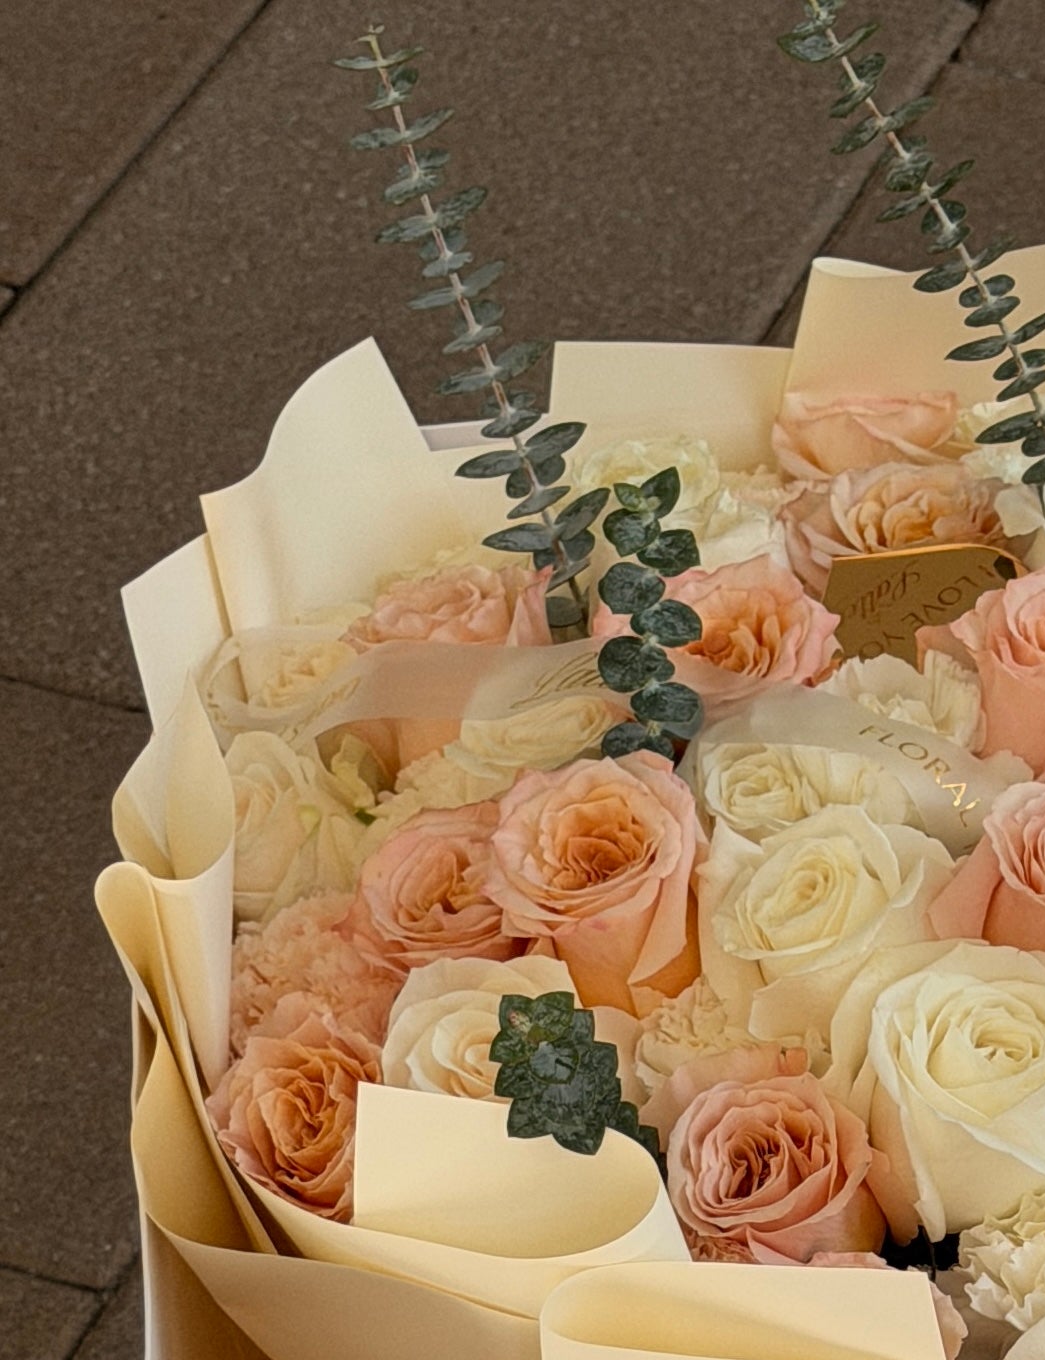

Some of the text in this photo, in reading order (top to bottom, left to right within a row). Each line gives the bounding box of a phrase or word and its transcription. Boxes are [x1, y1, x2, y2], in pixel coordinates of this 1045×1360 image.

[901, 575, 980, 629] LOVE
[858, 631, 905, 660] YO
[859, 724, 981, 828] FLORAL
